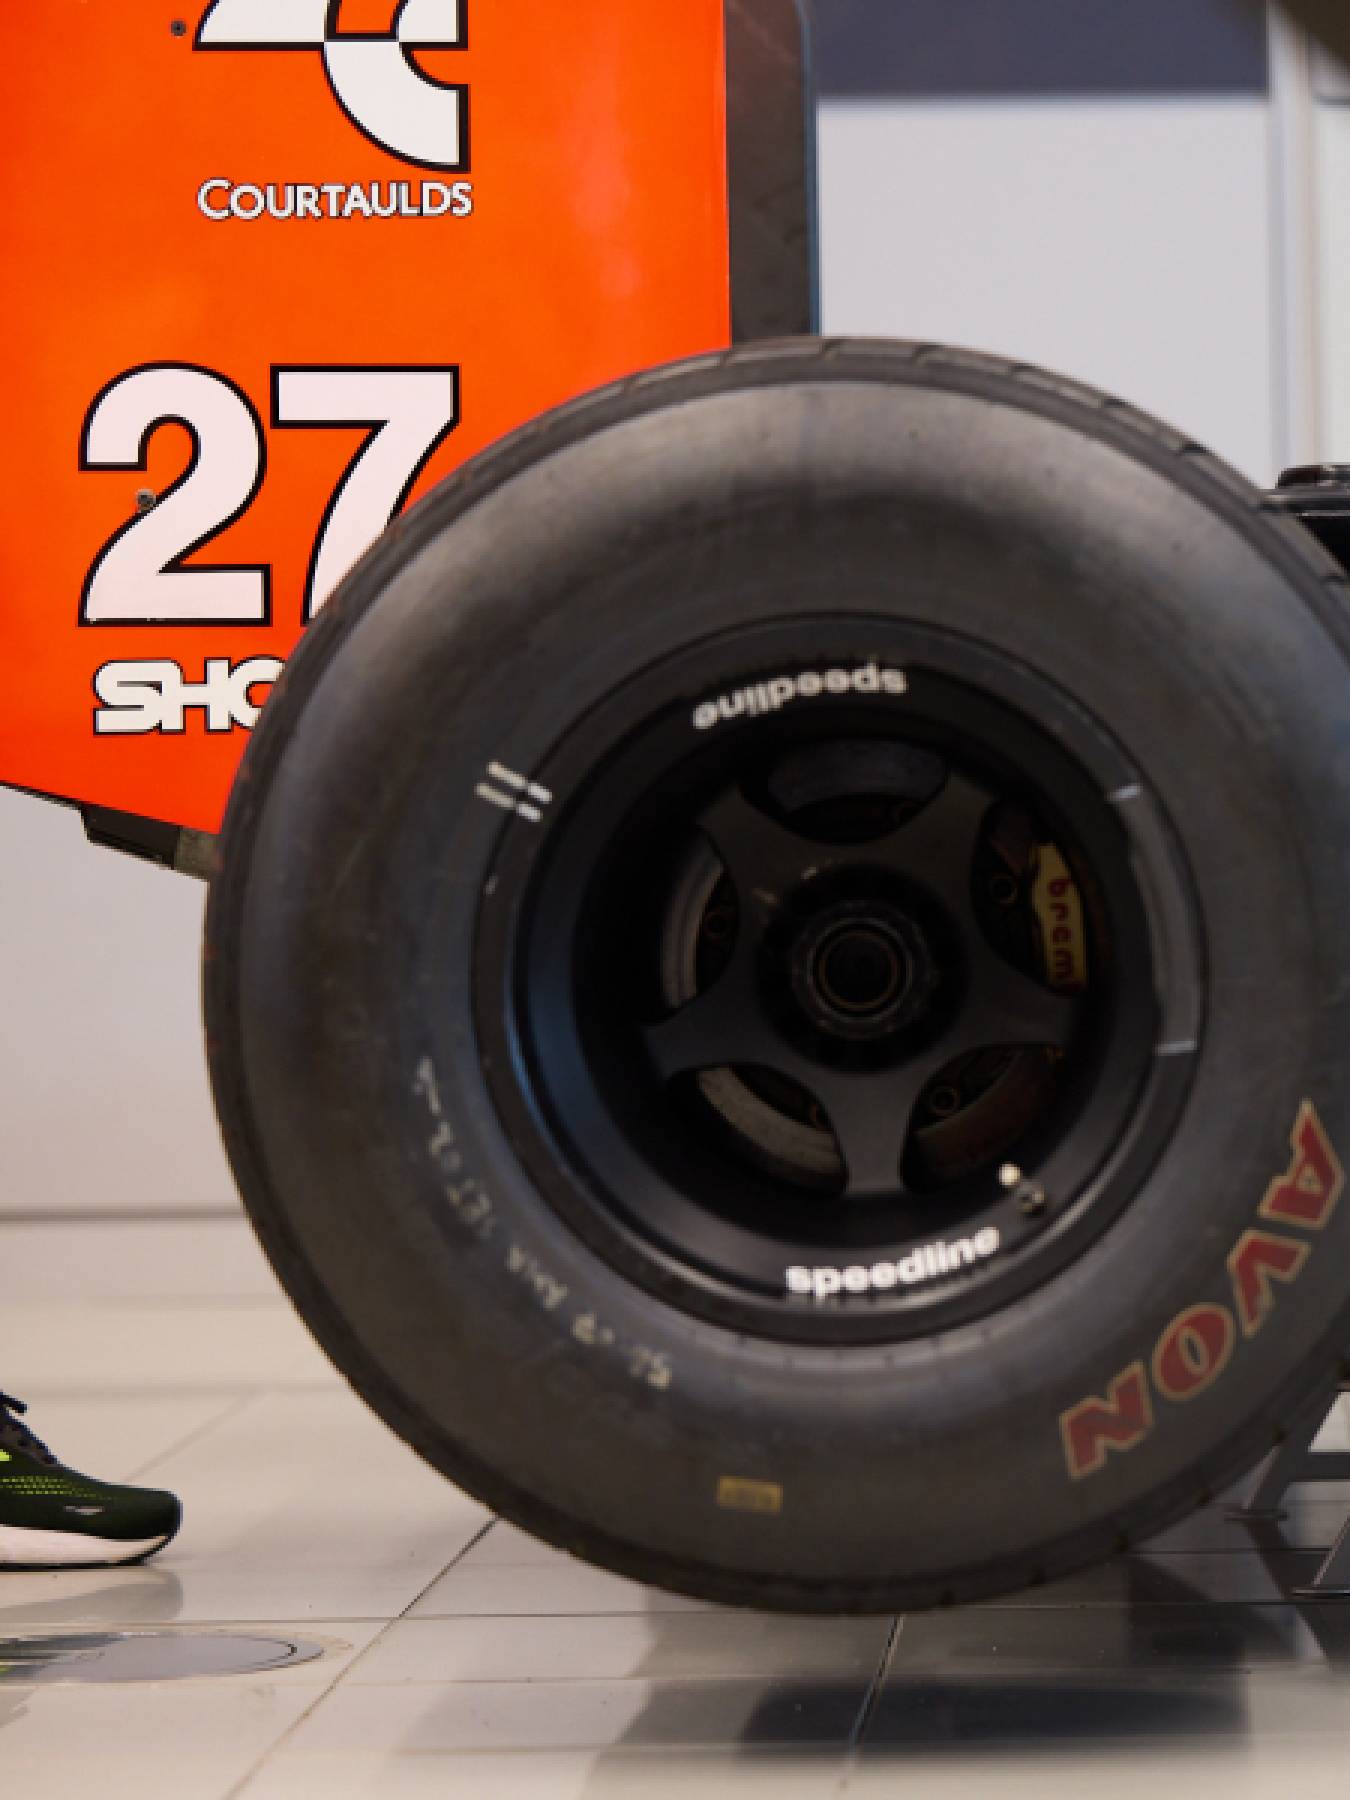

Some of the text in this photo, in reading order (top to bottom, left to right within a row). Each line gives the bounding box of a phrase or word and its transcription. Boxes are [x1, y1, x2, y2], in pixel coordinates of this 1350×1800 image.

[198, 178, 472, 219] COURTAULDS
[79, 361, 459, 625] 27
[693, 661, 907, 729] speedline
[786, 1226, 999, 1300] speedline
[1059, 1098, 1346, 1480] AVON
